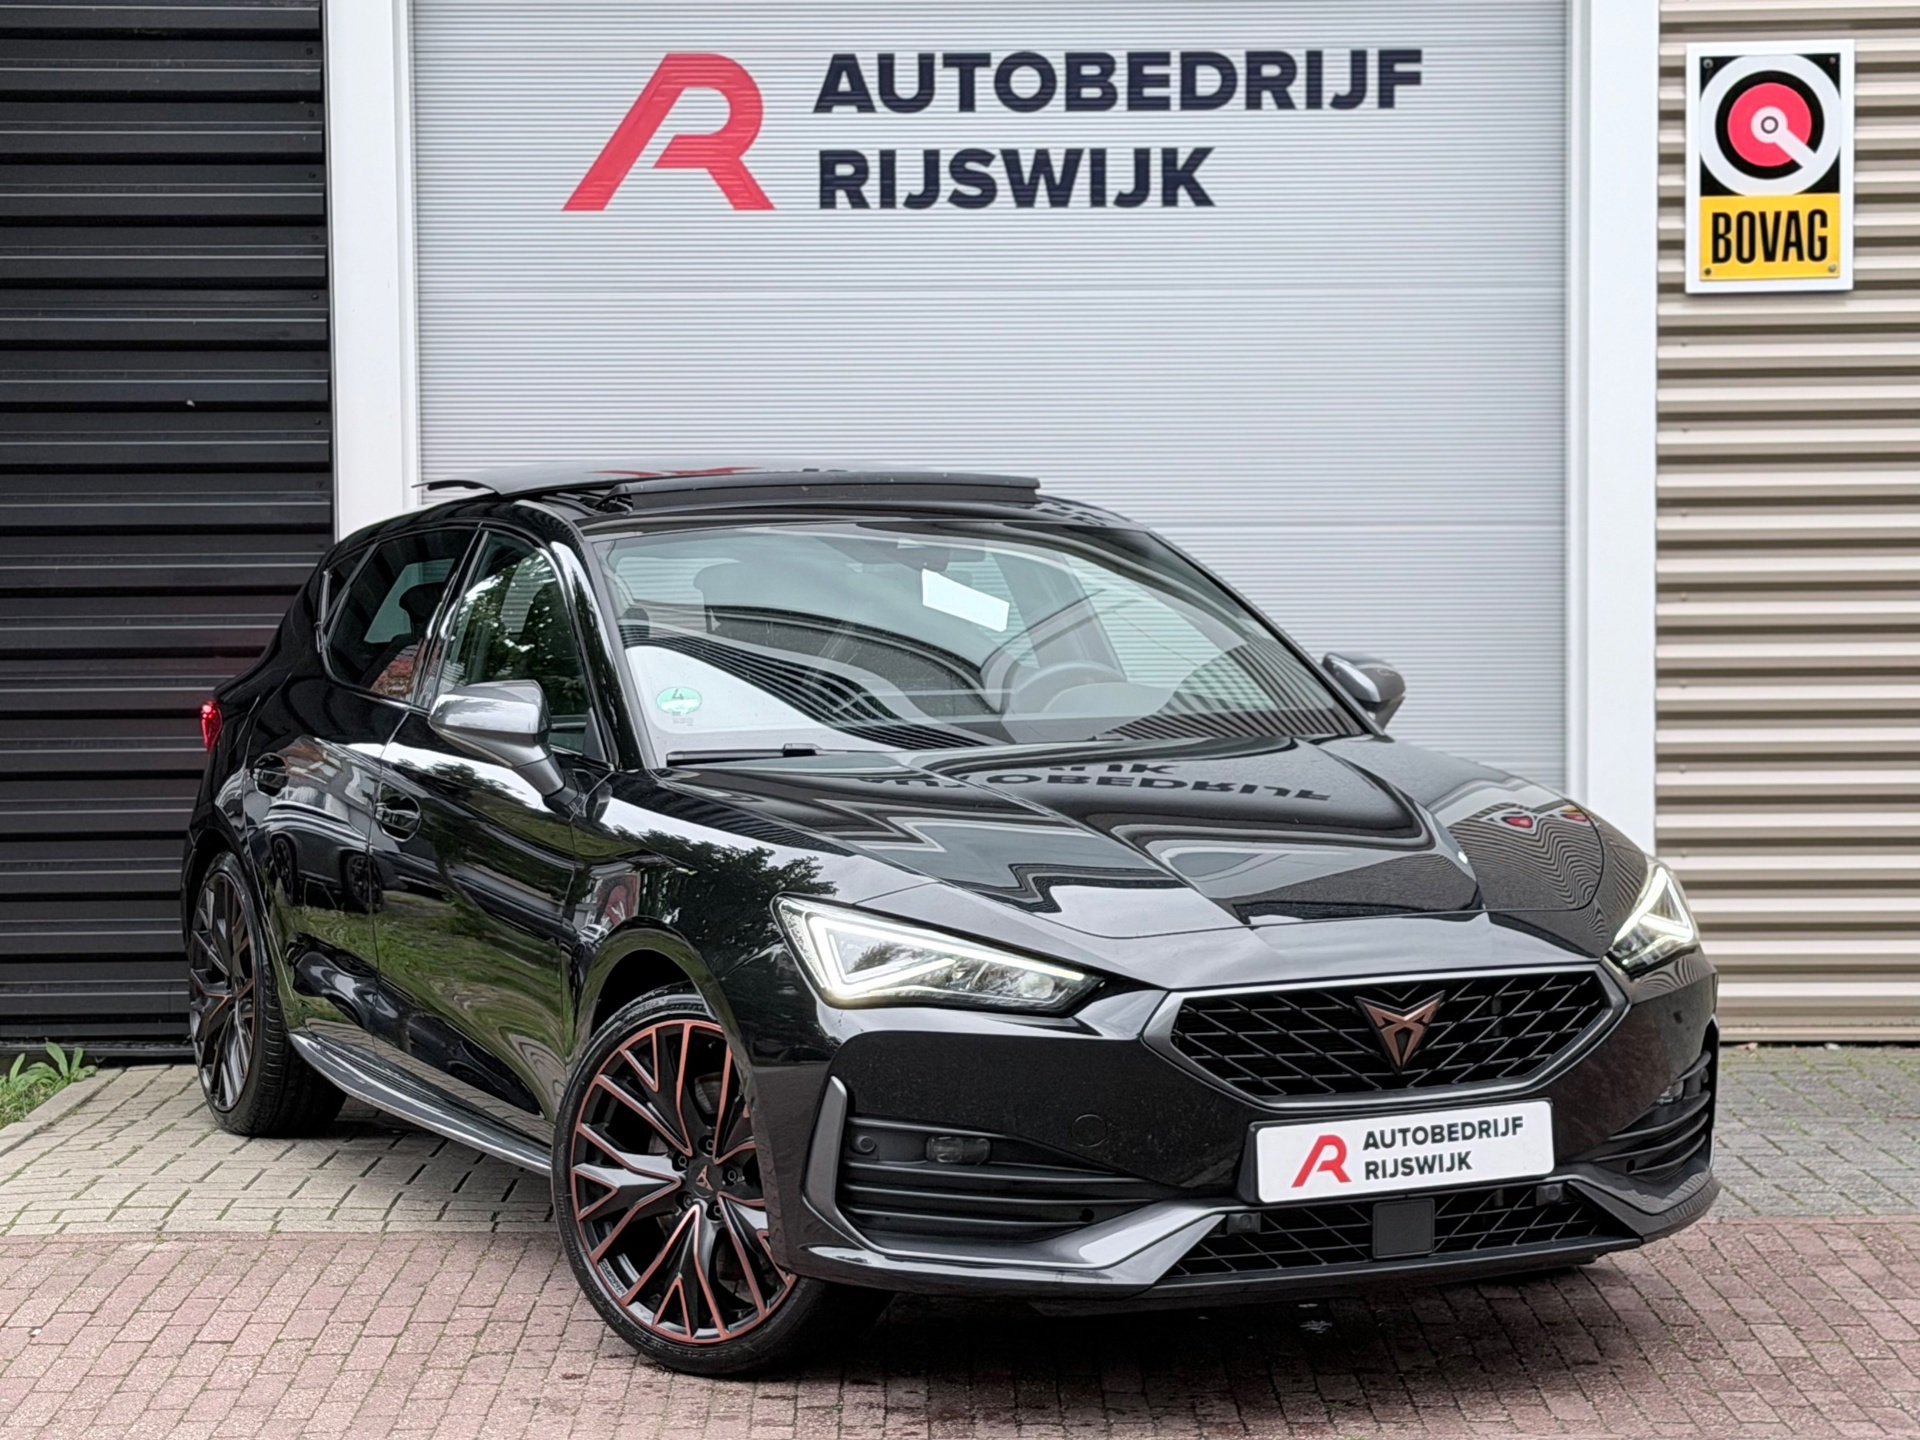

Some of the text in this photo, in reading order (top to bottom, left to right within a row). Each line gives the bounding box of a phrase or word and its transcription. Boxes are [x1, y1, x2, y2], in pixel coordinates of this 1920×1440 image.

[814, 48, 1422, 114] AUTOBEDRIJF
[819, 147, 1214, 210] RIJSWIJK
[1711, 208, 1829, 264] BOVAG
[1362, 1116, 1524, 1151] AUTOBEDRIJF
[1364, 1151, 1473, 1180] RIJSWIJK
